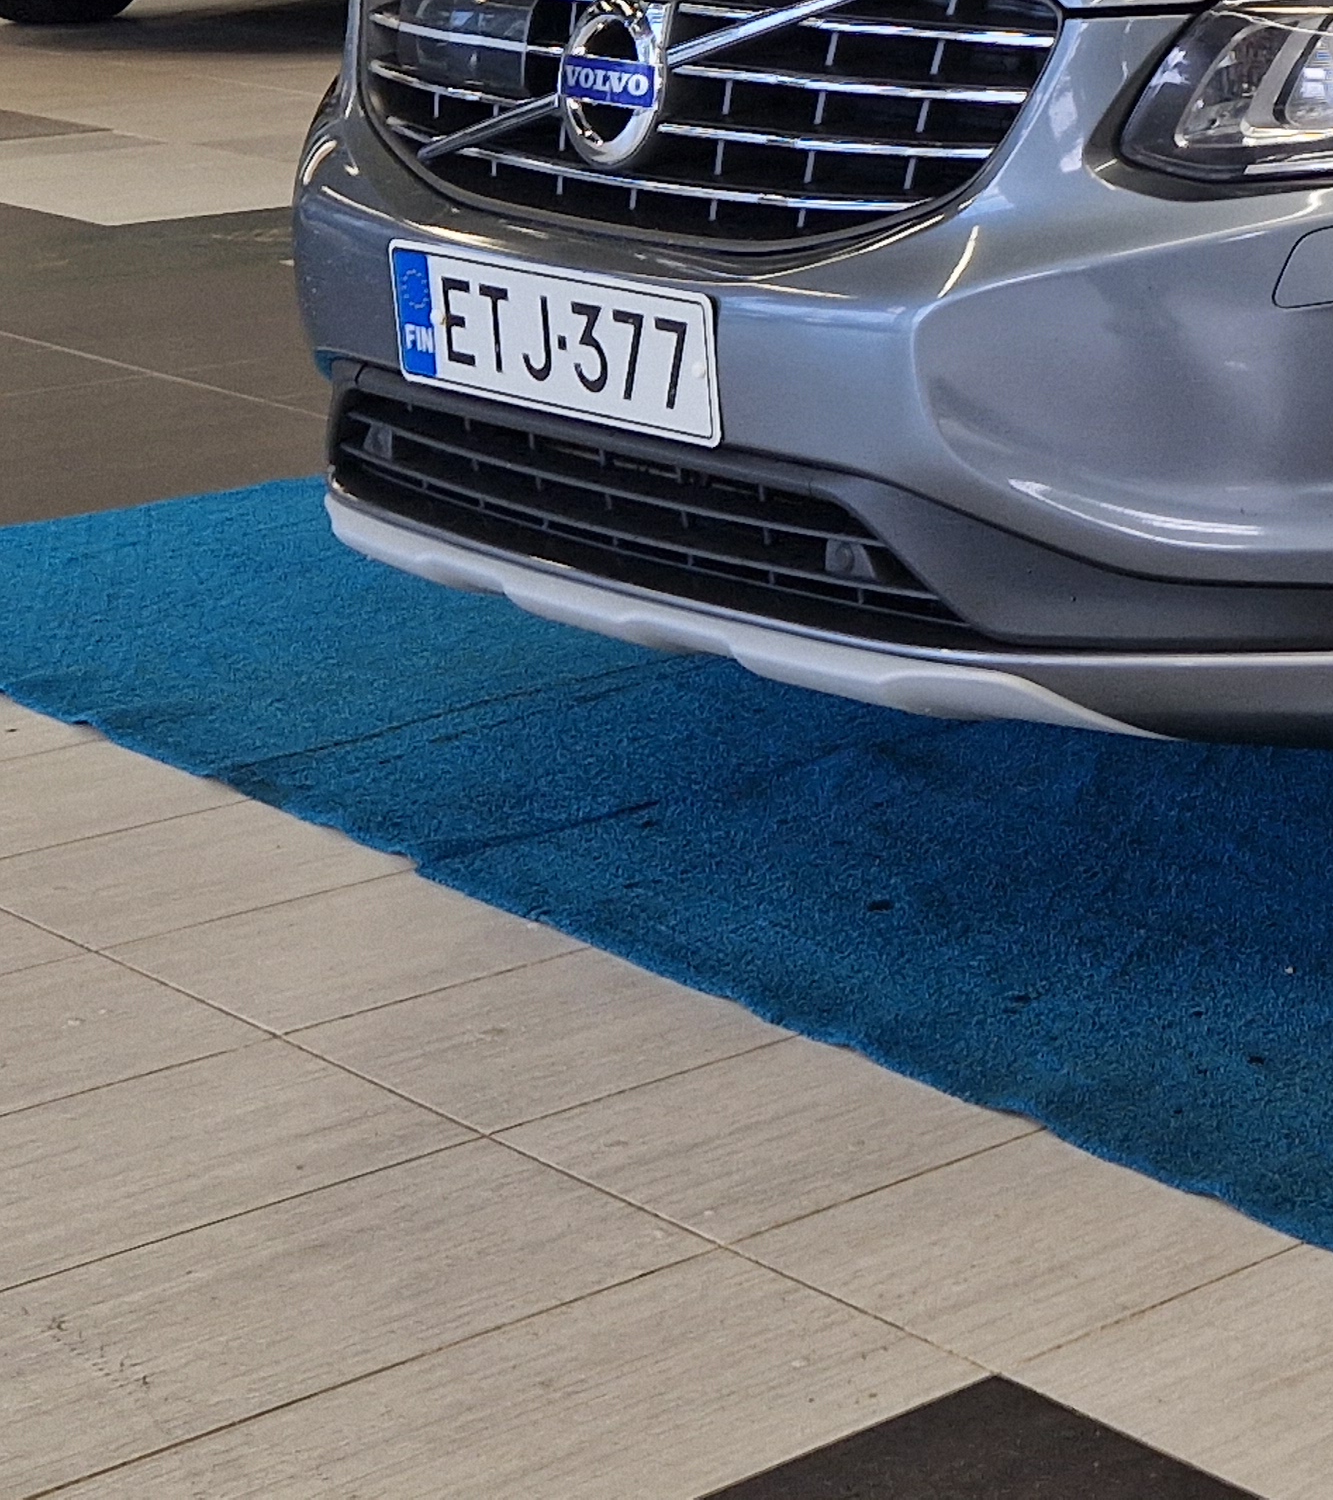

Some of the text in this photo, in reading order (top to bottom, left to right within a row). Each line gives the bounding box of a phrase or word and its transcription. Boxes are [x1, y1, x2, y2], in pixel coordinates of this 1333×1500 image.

[564, 65, 649, 97] VOLVO
[404, 323, 434, 354] FIN
[440, 276, 688, 410] ETJ-377
